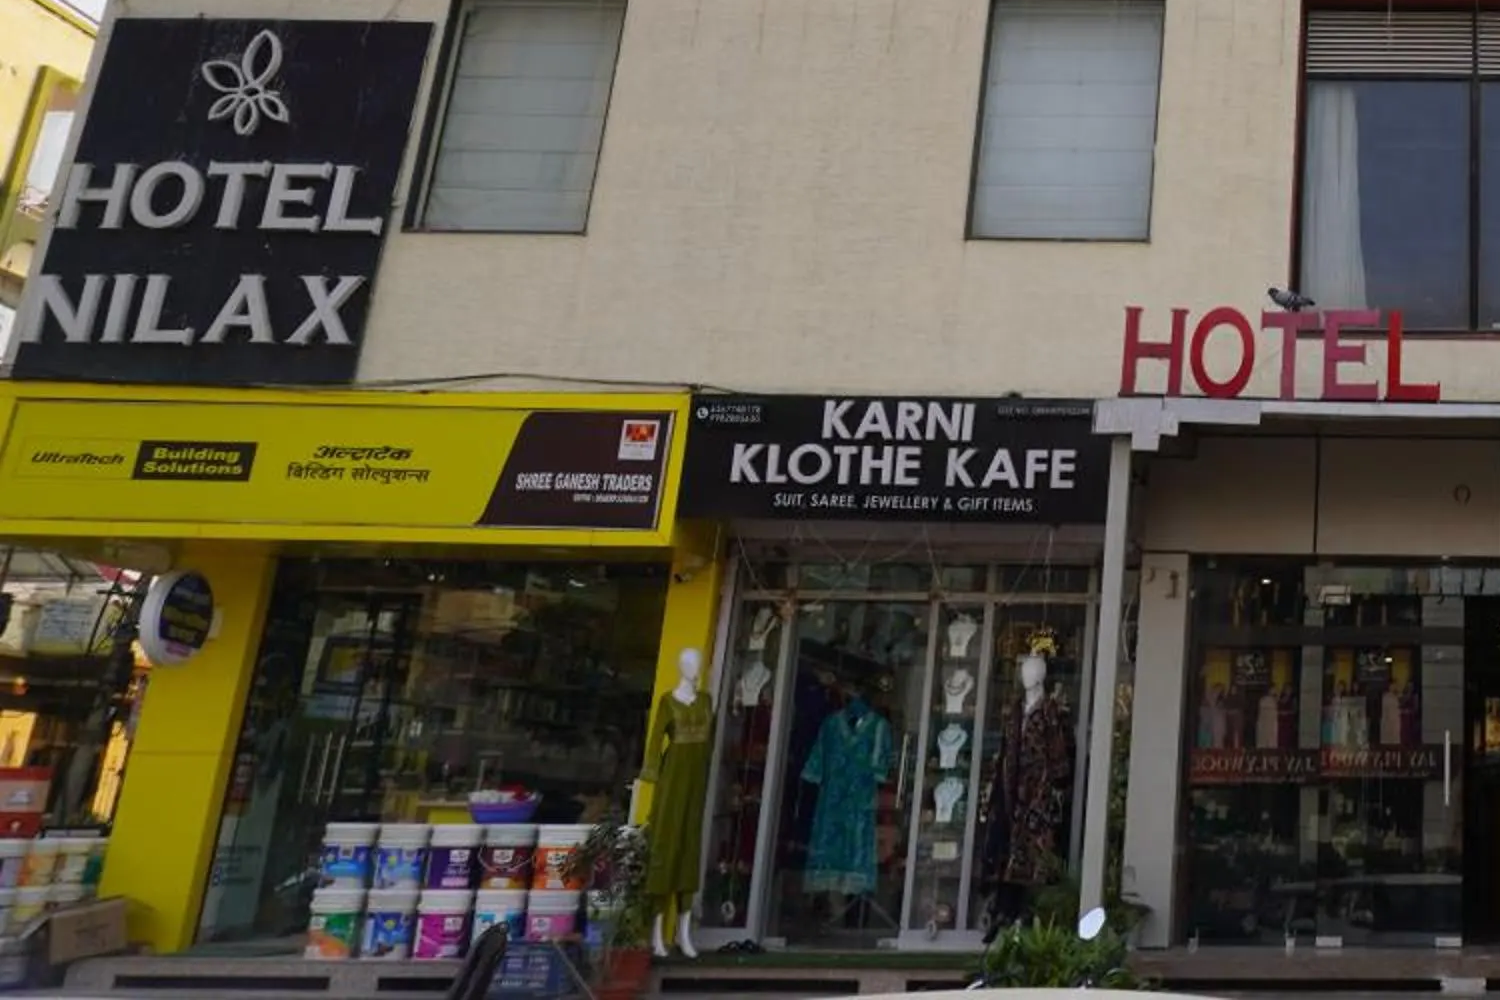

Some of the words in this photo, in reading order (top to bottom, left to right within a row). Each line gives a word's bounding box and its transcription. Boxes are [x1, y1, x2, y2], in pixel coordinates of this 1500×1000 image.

[55, 160, 384, 236] HOTEL
[20, 273, 368, 345] NILAX
[1119, 306, 1441, 404] HOTEL
[821, 400, 976, 442] KARNI
[31, 451, 126, 465] UltraTech
[143, 462, 243, 475] Solutions
[153, 447, 241, 463] Building
[729, 443, 921, 486] KLOTHE
[945, 448, 1078, 489] KAFE
[515, 472, 553, 491] SHREE
[554, 472, 600, 491] GANESH
[602, 474, 653, 492] TRADERS
[863, 495, 938, 510] JEWELLERY
[957, 497, 989, 512] GIFT
[992, 498, 1033, 512] ITEMS
